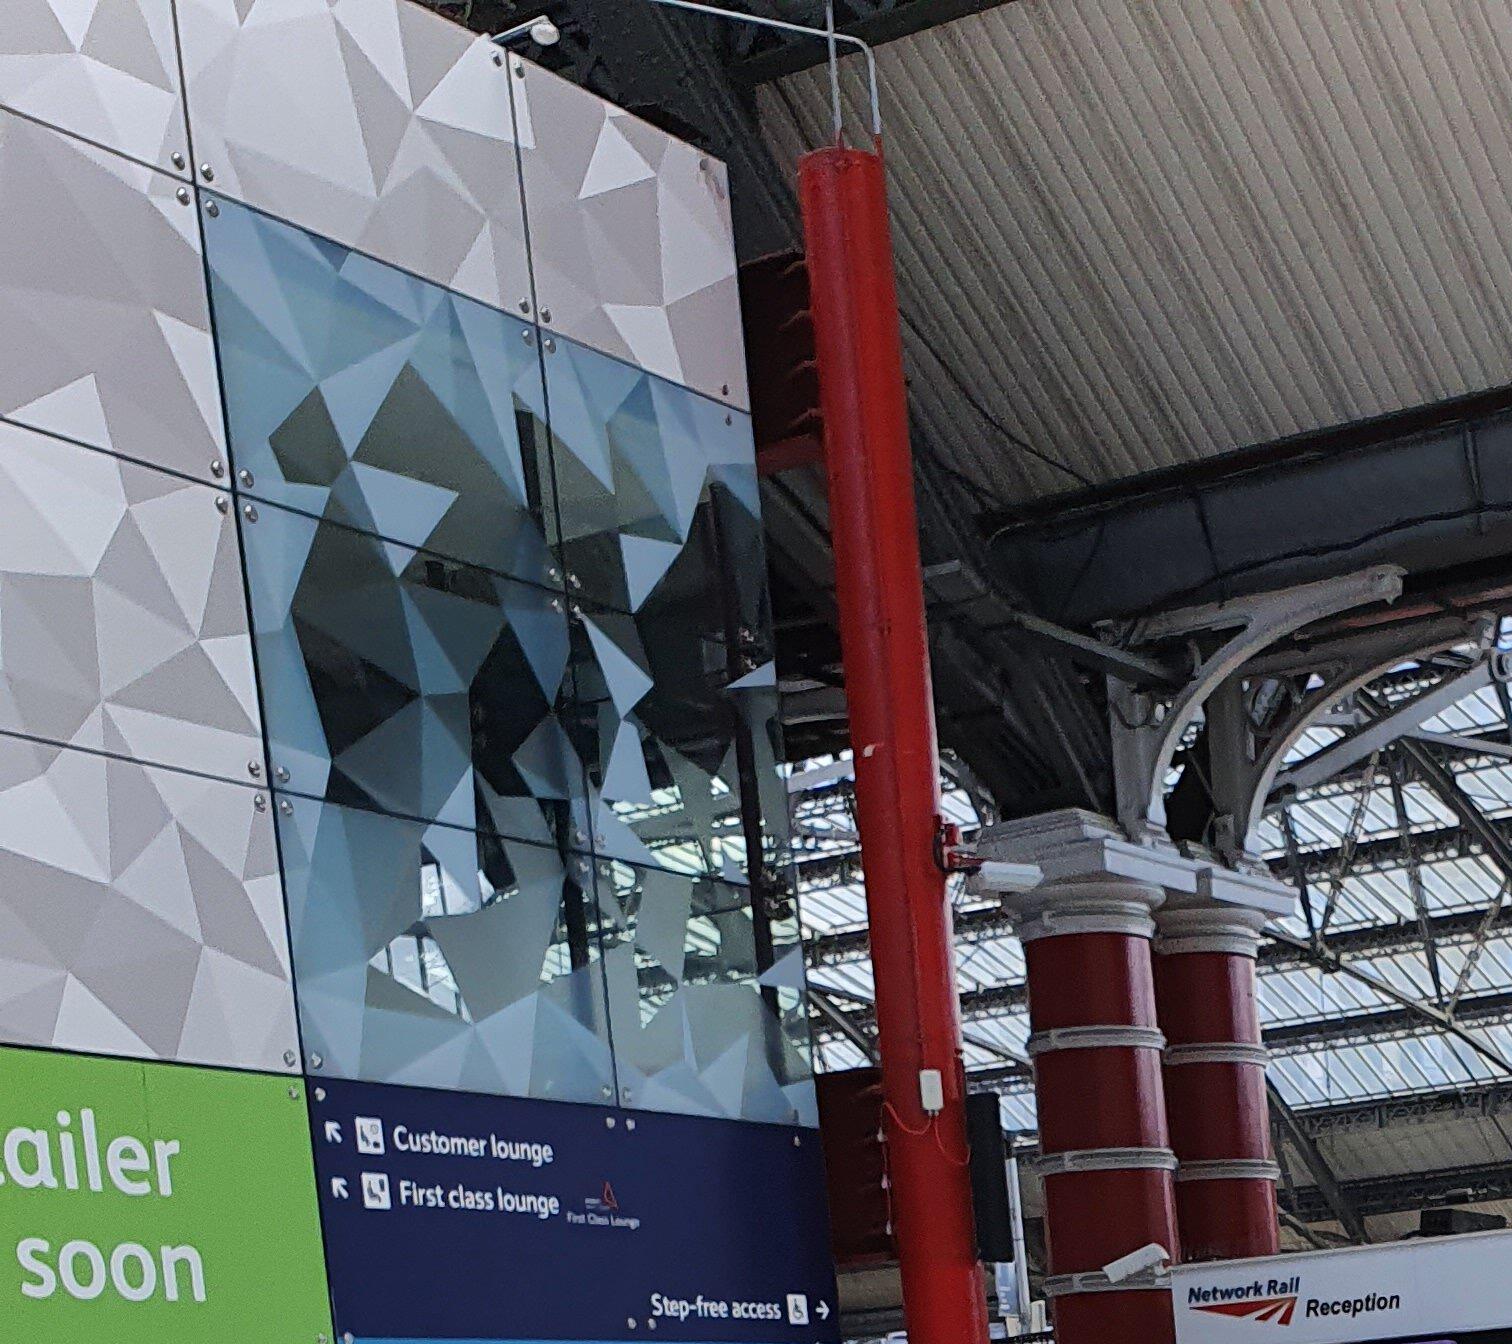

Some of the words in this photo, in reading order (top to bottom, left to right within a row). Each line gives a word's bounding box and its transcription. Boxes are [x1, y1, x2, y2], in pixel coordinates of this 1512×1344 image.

[0, 1108, 180, 1198] ailer
[393, 1124, 488, 1158] Customer
[490, 1132, 555, 1168] lounge
[400, 1179, 446, 1208] First
[449, 1184, 495, 1211] class
[497, 1186, 561, 1220] lounge
[16, 1237, 207, 1302] soon
[1188, 1281, 1263, 1303] Network
[1267, 1277, 1300, 1295] Rail
[651, 1292, 729, 1322] Step-free
[732, 1301, 782, 1320] access
[1306, 1293, 1400, 1318] Reception
